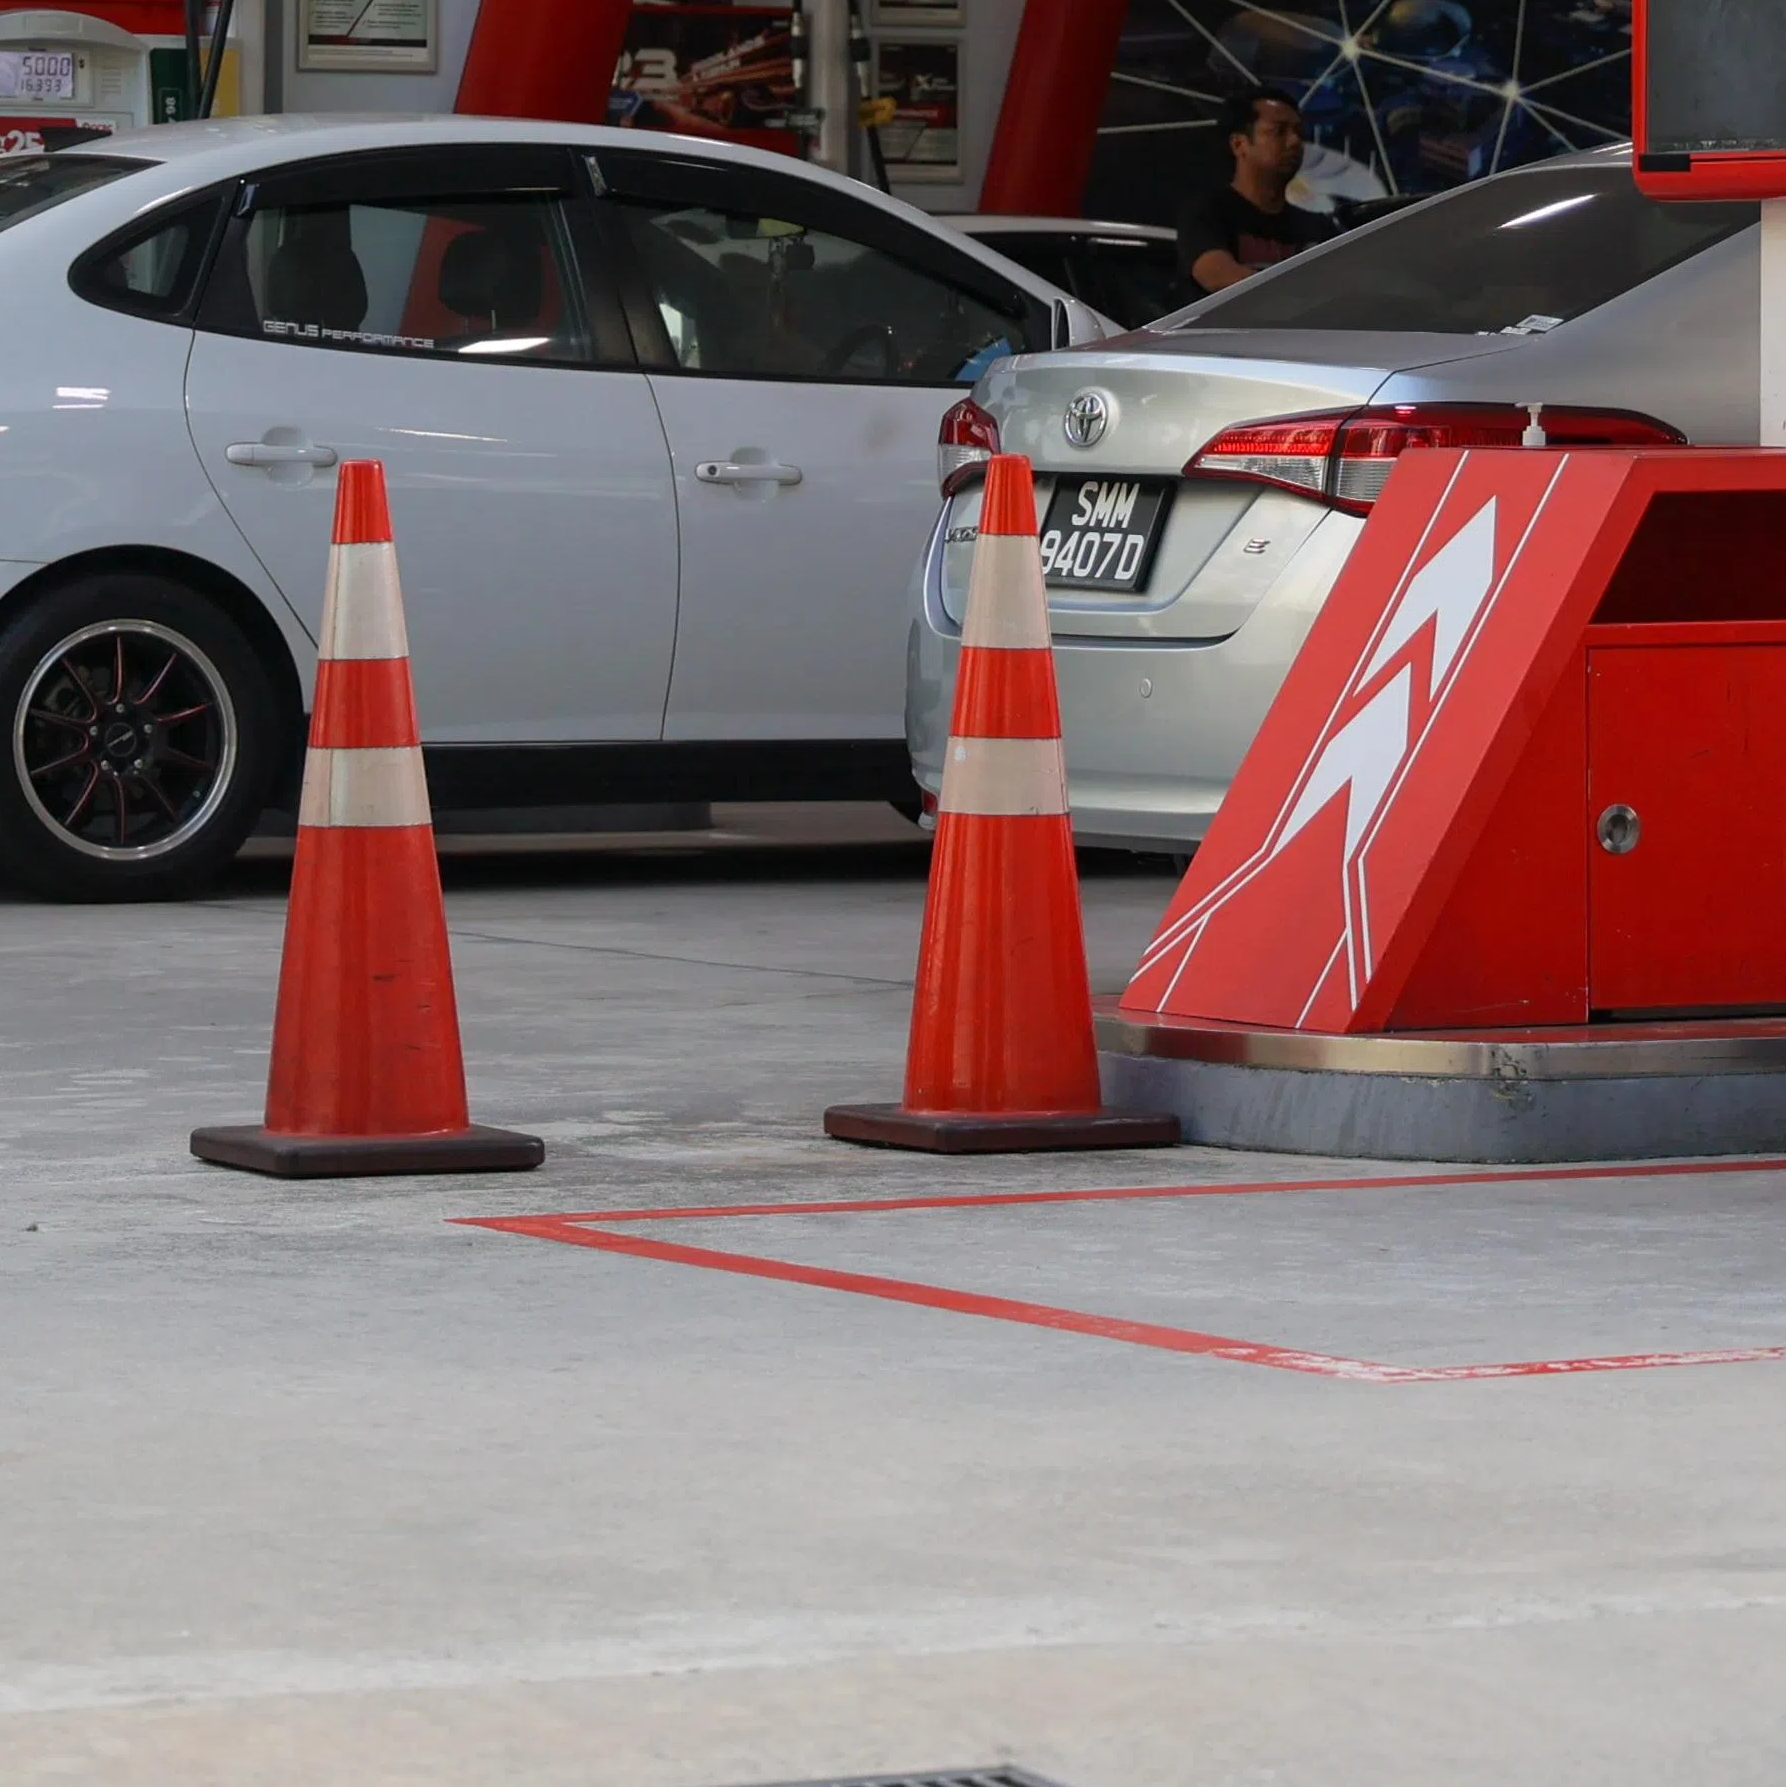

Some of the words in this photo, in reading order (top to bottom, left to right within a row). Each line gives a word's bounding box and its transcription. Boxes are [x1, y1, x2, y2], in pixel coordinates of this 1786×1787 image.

[264, 319, 320, 338] GENUS
[322, 328, 435, 350] PERFORMANCE
[1071, 481, 1141, 529] SMM
[1040, 530, 1144, 582] 9407D
